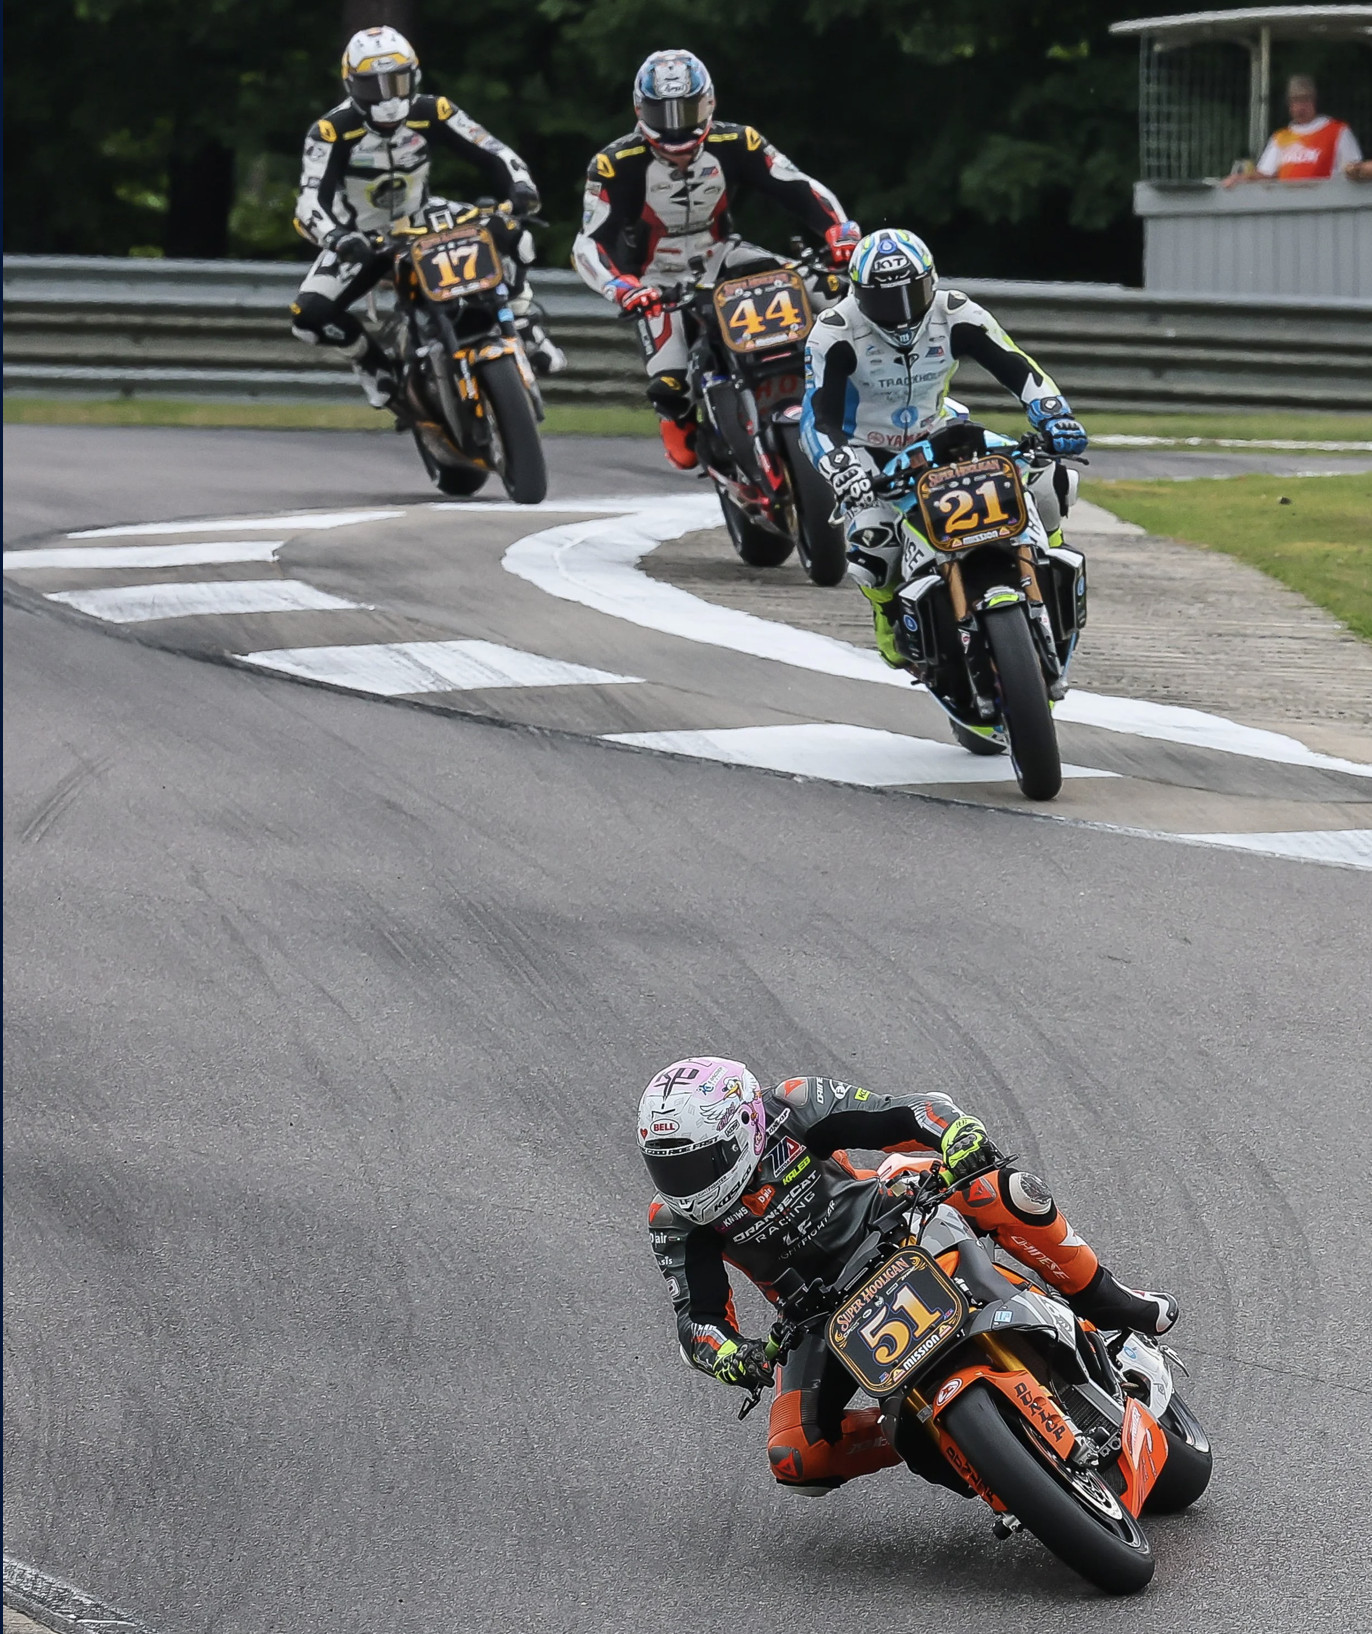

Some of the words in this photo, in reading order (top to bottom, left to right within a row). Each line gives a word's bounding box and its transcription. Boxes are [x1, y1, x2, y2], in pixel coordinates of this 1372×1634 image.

[431, 243, 479, 287] 17
[874, 256, 904, 271] KYT
[729, 290, 802, 334] 44
[939, 479, 1010, 534] 21
[653, 1122, 676, 1132] BELL
[782, 1156, 811, 1186] KALEB
[836, 1298, 866, 1332] SUPER
[860, 1257, 911, 1303] HOOLIGAN
[859, 1284, 942, 1365] 51
[902, 1333, 941, 1371] mission
